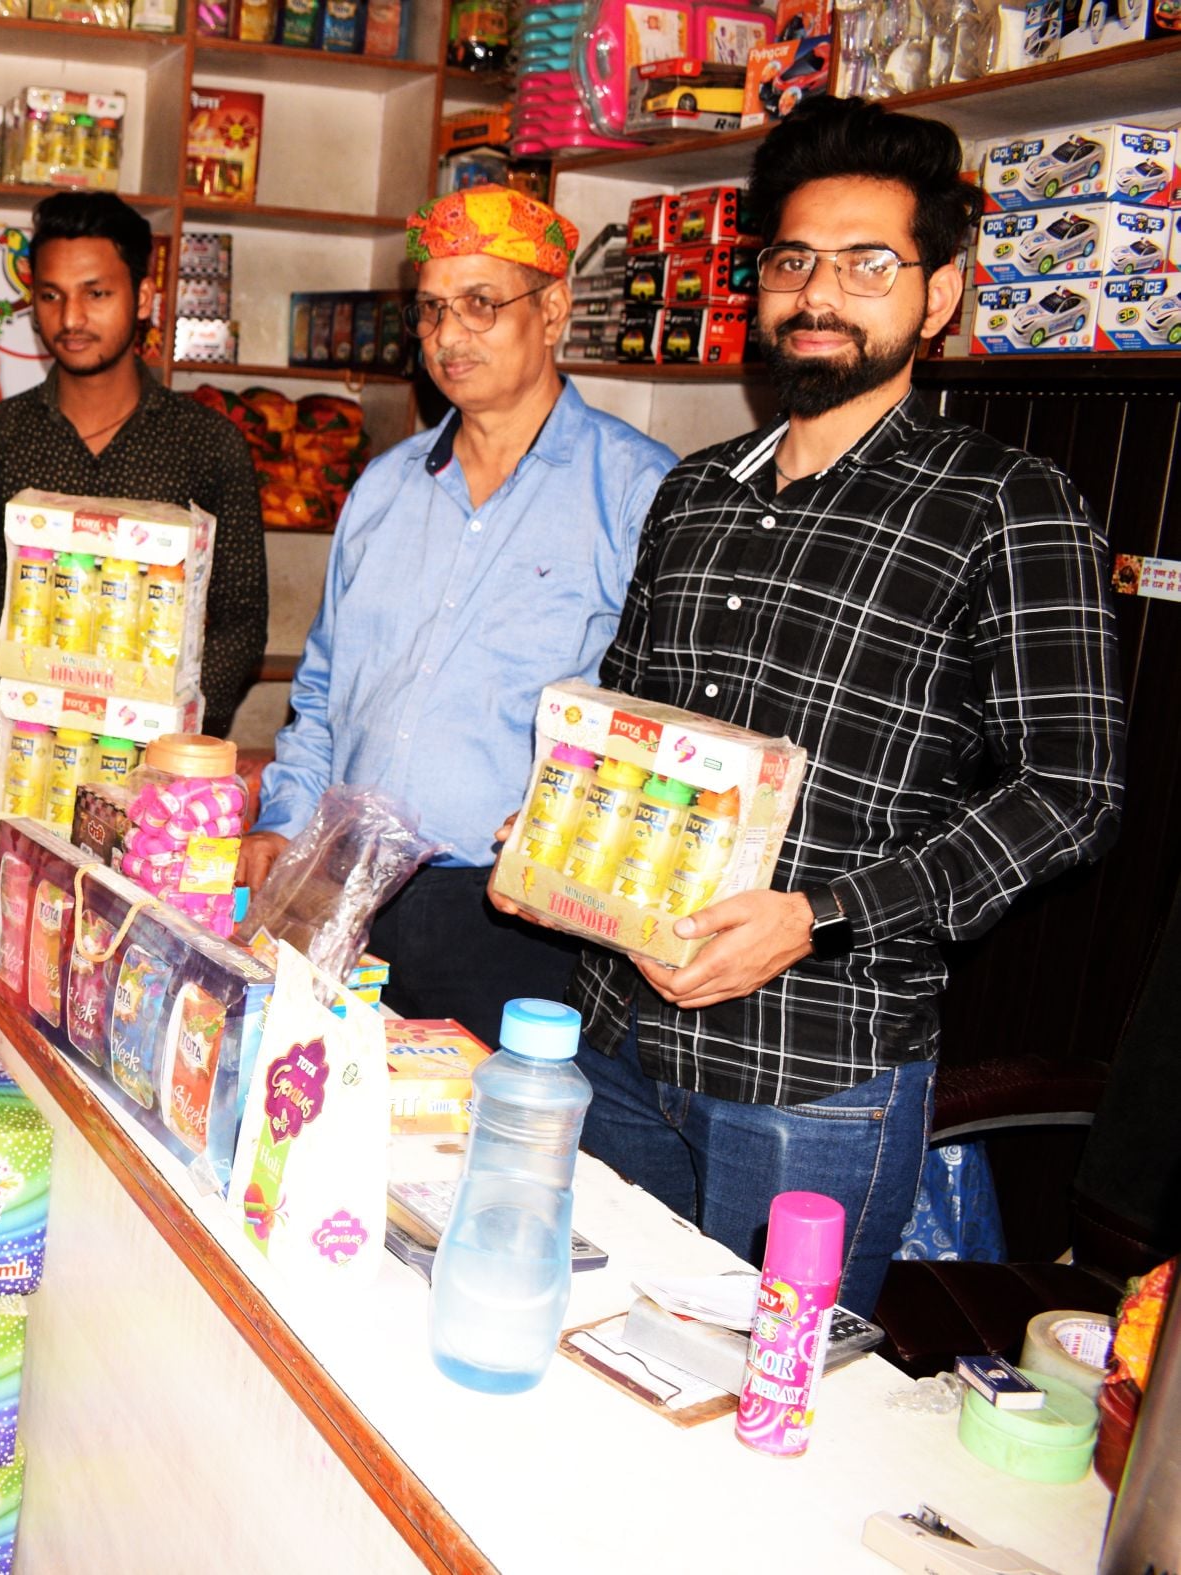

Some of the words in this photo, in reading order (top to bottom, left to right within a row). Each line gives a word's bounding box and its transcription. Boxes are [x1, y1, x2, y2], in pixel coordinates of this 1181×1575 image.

[1023, 142, 1039, 155] ICE
[1017, 217, 1033, 229] ICE
[1011, 289, 1027, 302] ICE
[1109, 283, 1128, 296] POL
[1144, 281, 1163, 294] ICE
[1118, 309, 1137, 324] 3D
[612, 719, 642, 740] TOTA
[102, 757, 127, 770] TOTA
[549, 891, 618, 941] THUNDER
[117, 984, 132, 1008] OTA
[181, 1030, 203, 1062] TOTA
[296, 1053, 319, 1080] TOTA
[754, 1315, 778, 1343] OSS
[748, 1338, 795, 1381] LOR
